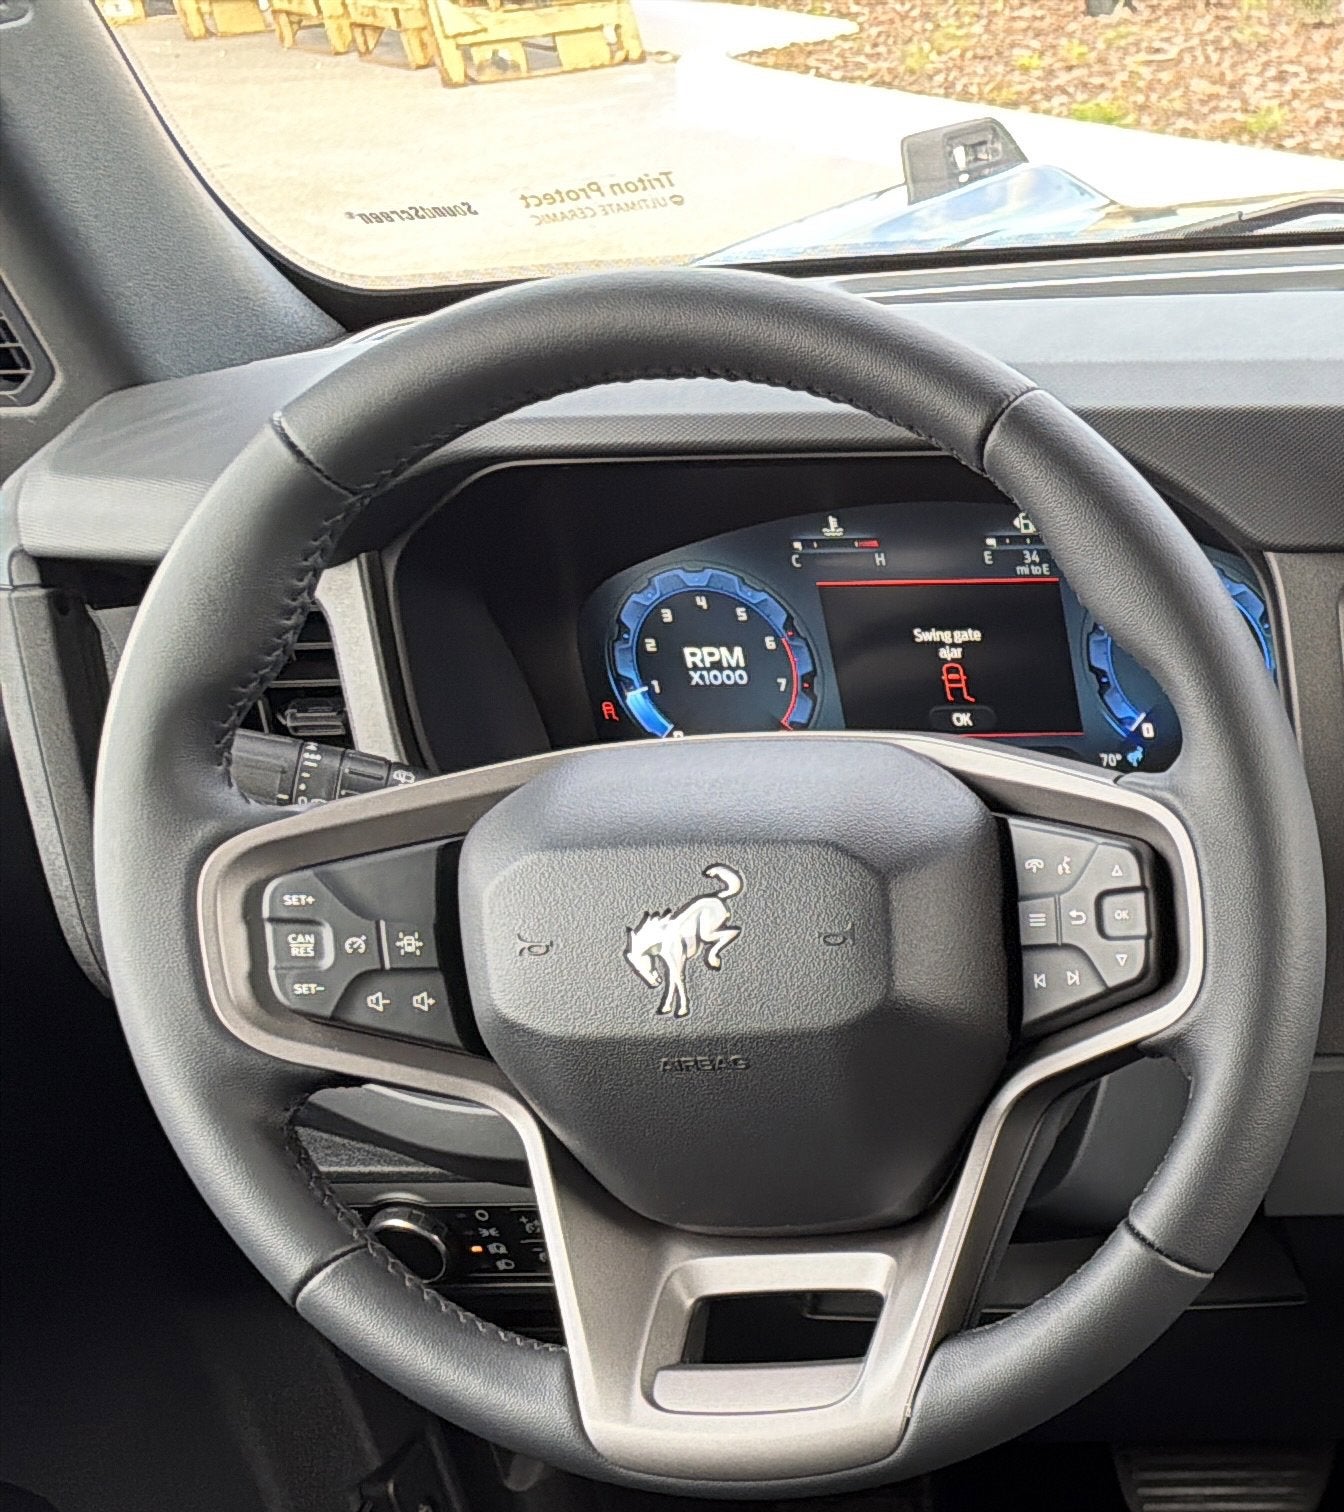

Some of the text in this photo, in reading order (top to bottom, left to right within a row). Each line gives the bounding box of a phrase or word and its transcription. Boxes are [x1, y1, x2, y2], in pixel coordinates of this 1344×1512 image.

[791, 554, 801, 568] C
[874, 553, 886, 566] H
[984, 551, 993, 564] E
[1023, 550, 1040, 564] 34
[1016, 564, 1050, 575] mi to E
[695, 596, 708, 610] 4
[660, 608, 673, 623] 3
[735, 607, 748, 621] 5
[764, 636, 777, 650] 6
[913, 628, 982, 644] Swing gate
[644, 638, 657, 652] 2
[683, 646, 745, 668] RPM
[938, 647, 963, 661] ajar
[688, 669, 748, 686] X1000
[651, 680, 661, 693] 1
[776, 678, 787, 692] 7
[952, 713, 973, 727] OK
[1141, 722, 1154, 738] 0
[1099, 753, 1122, 767] 70°
[282, 894, 316, 907] SET+
[1114, 910, 1130, 920] OK
[287, 934, 315, 944] CAN
[290, 947, 315, 957] RES
[658, 1055, 750, 1073] AIRBAG
